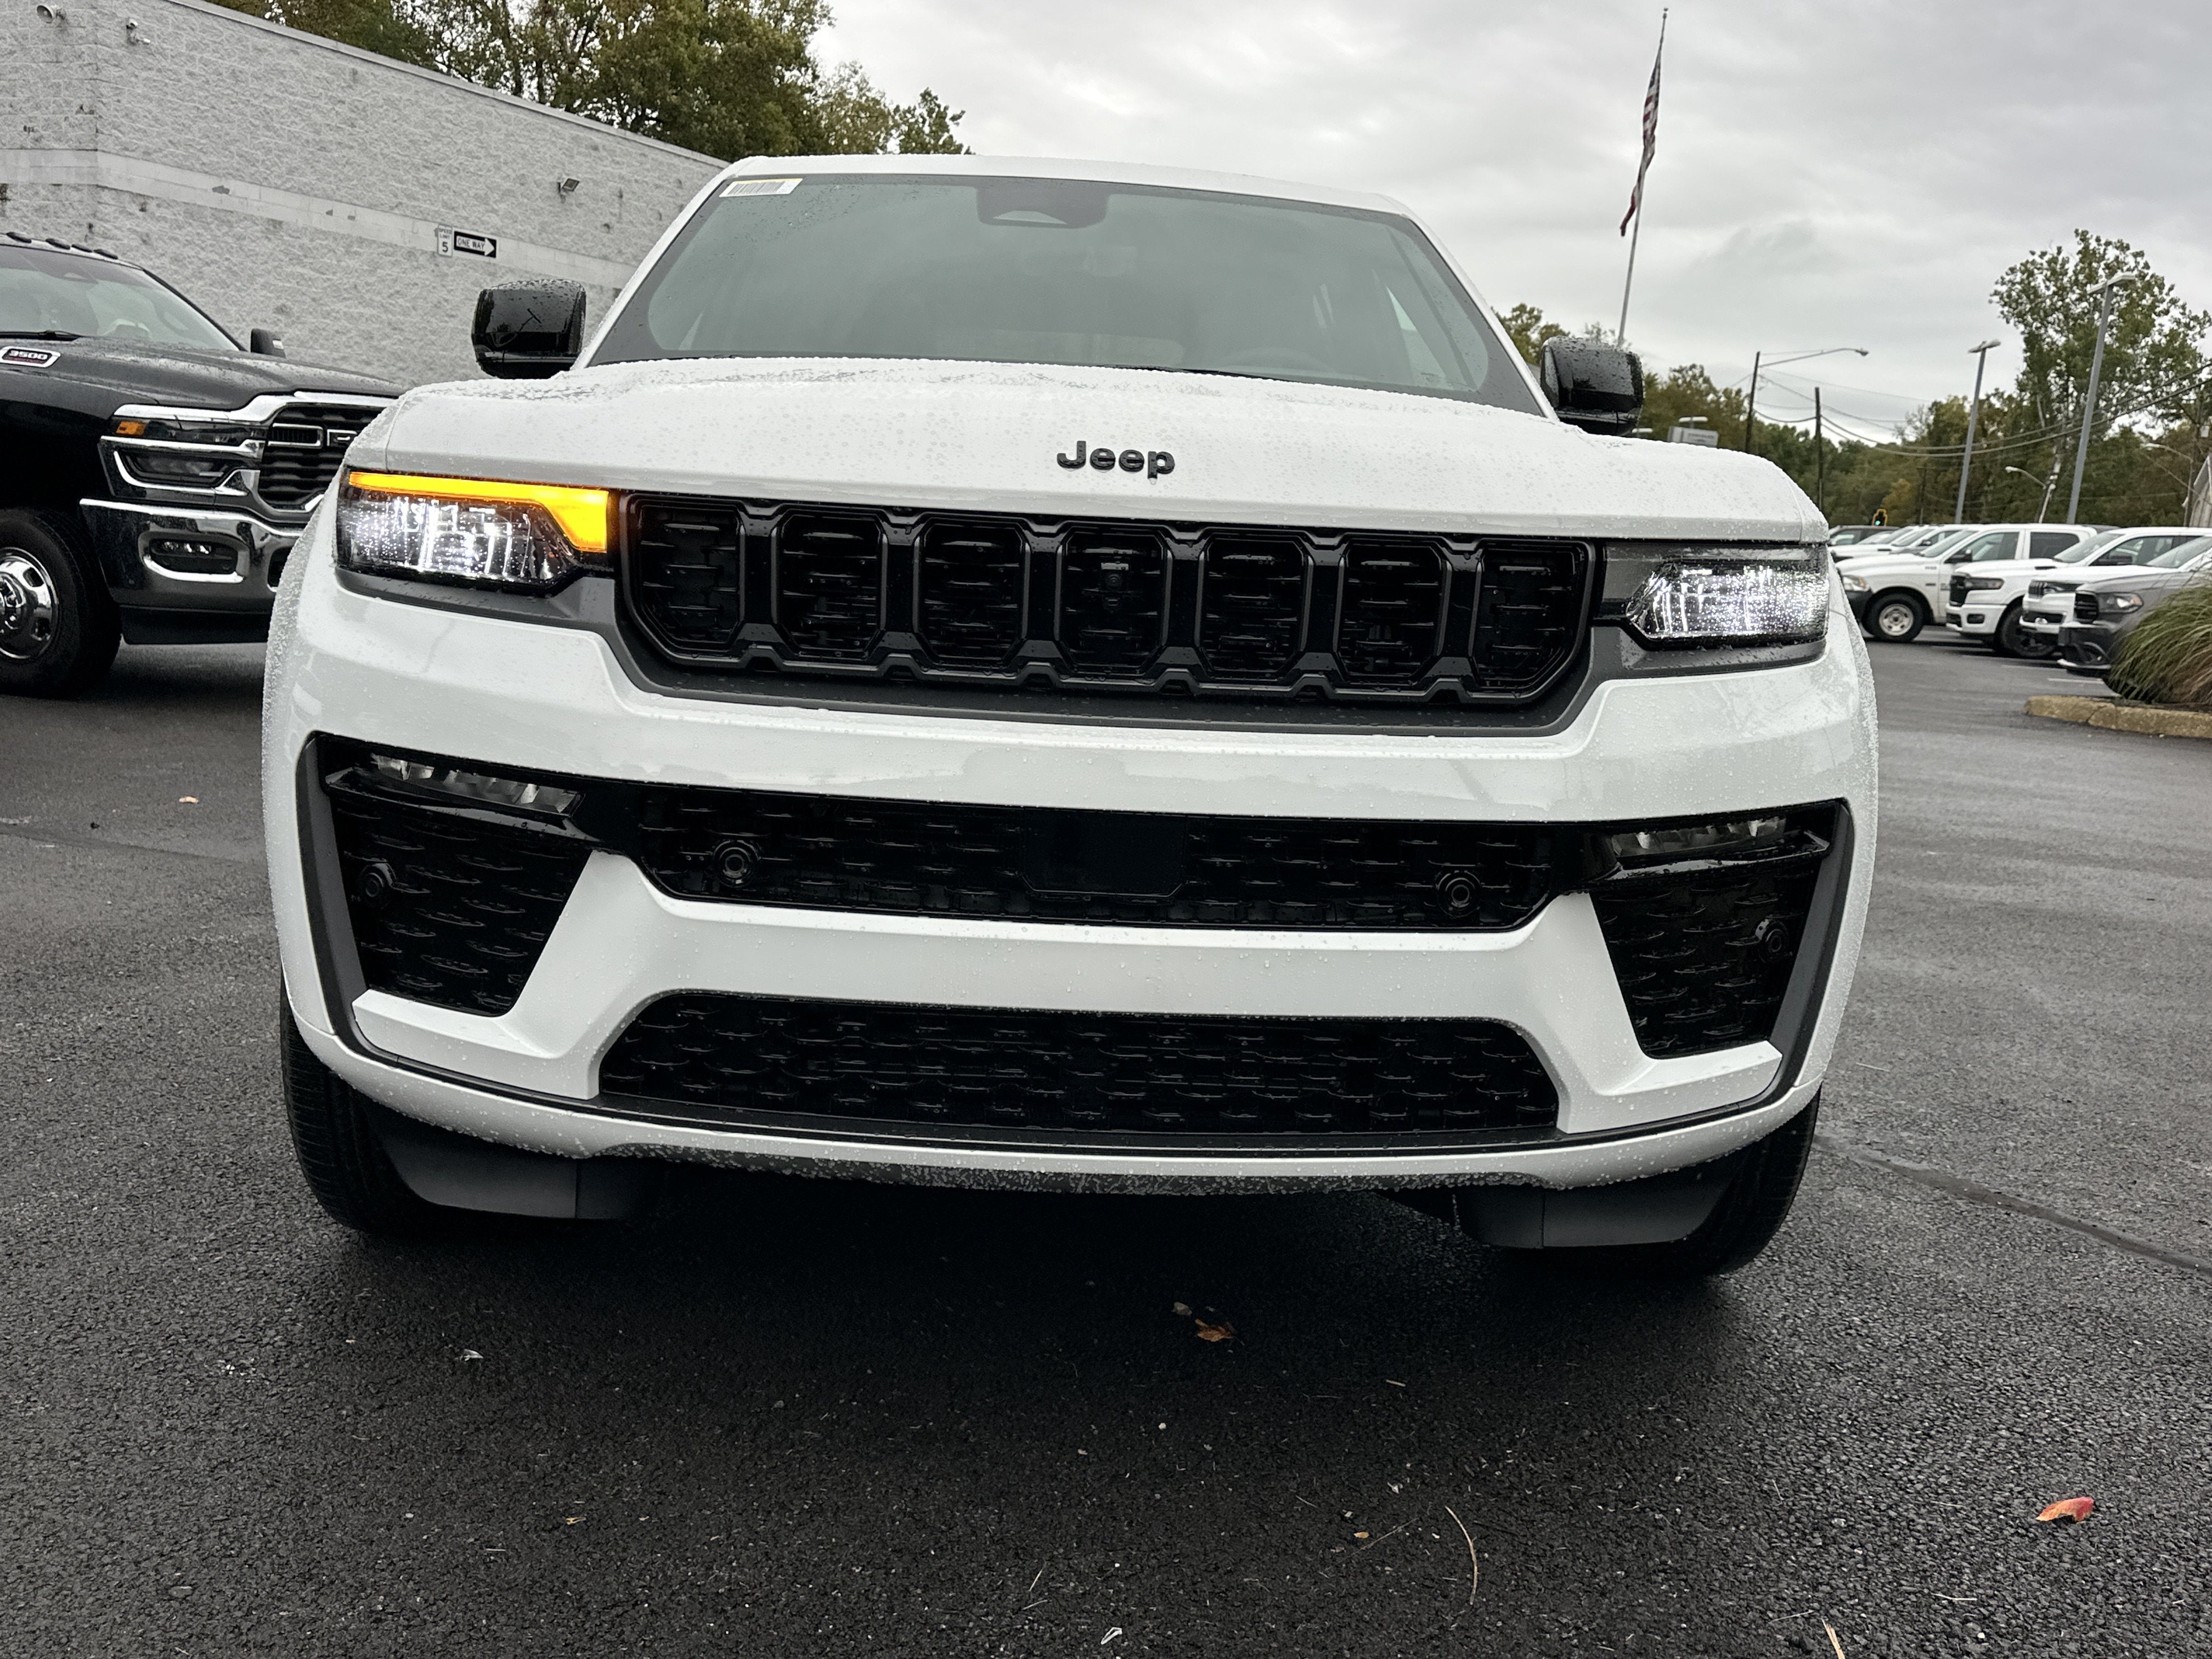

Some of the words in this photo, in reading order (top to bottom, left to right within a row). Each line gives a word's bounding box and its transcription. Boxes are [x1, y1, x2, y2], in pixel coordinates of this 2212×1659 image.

[442, 241, 449, 253] 5
[458, 237, 470, 247] ONE
[472, 241, 485, 250] WAY
[1057, 441, 1175, 479] Jeep
